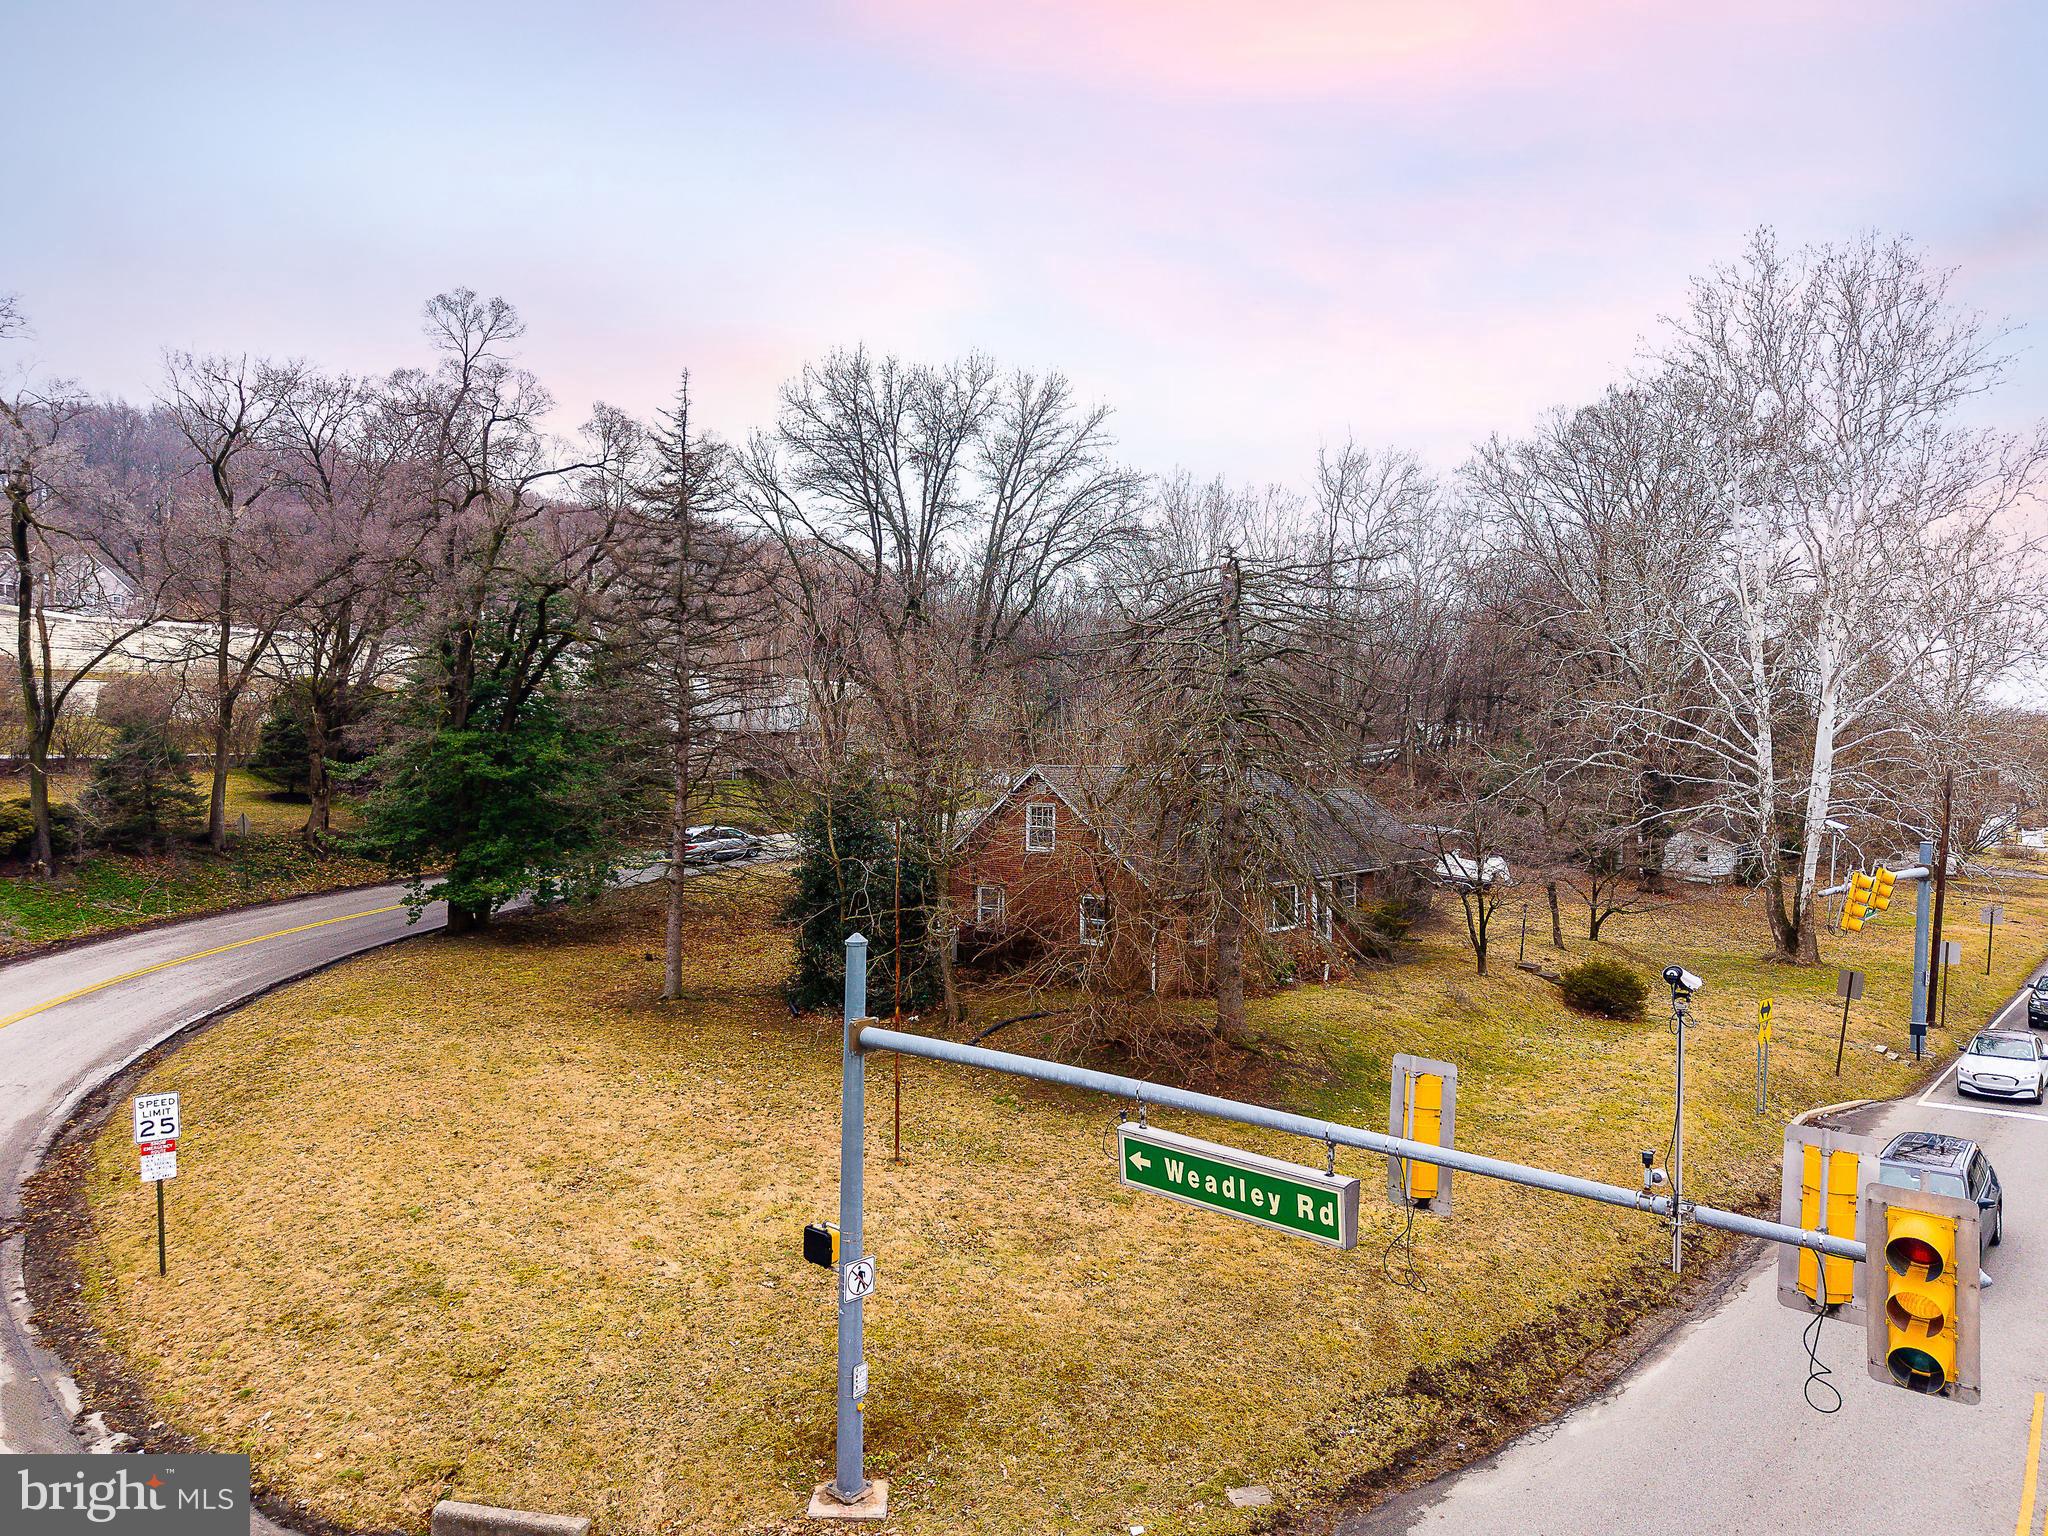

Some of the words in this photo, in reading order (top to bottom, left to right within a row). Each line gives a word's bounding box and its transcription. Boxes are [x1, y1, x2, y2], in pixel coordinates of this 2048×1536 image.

[138, 1098, 175, 1109] SPEED
[142, 1108, 171, 1118] LIMIT
[140, 1117, 175, 1137] 25
[1164, 1158, 1281, 1216] Weadley
[1297, 1193, 1334, 1227] Rd
